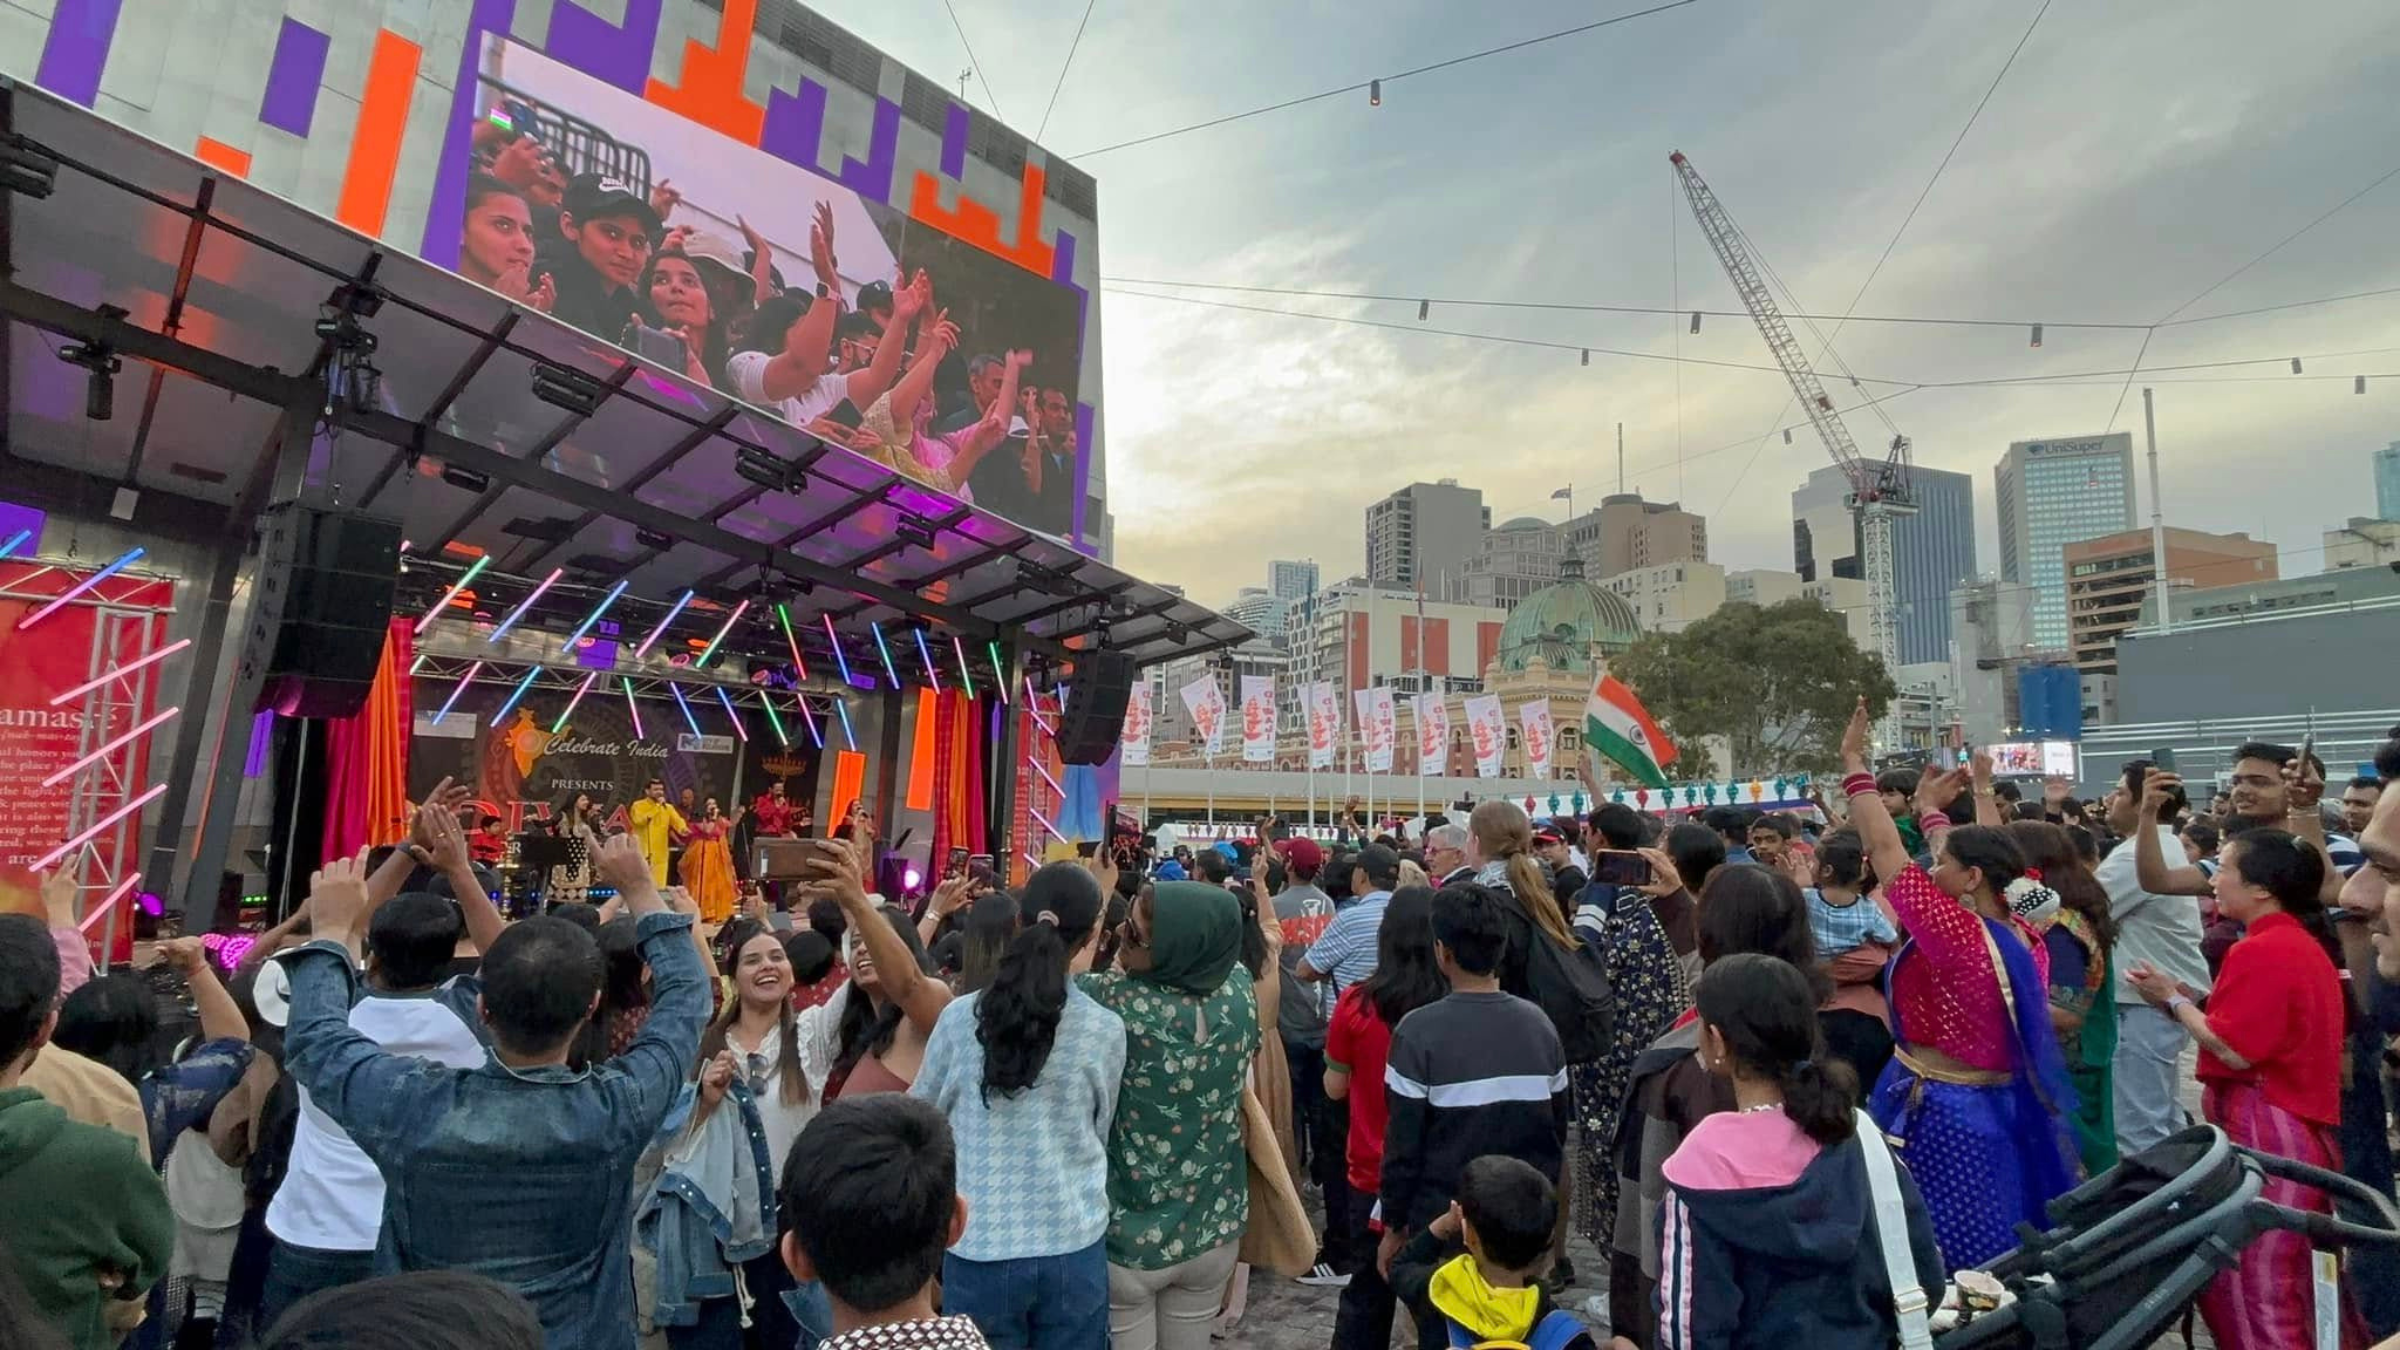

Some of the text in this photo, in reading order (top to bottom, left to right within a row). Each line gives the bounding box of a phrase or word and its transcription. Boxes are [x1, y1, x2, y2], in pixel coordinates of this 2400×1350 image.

[2045, 440, 2104, 454] UniSuper
[544, 735, 620, 755] Celebrate
[627, 740, 669, 758] India
[551, 779, 614, 791] PRESENTS
